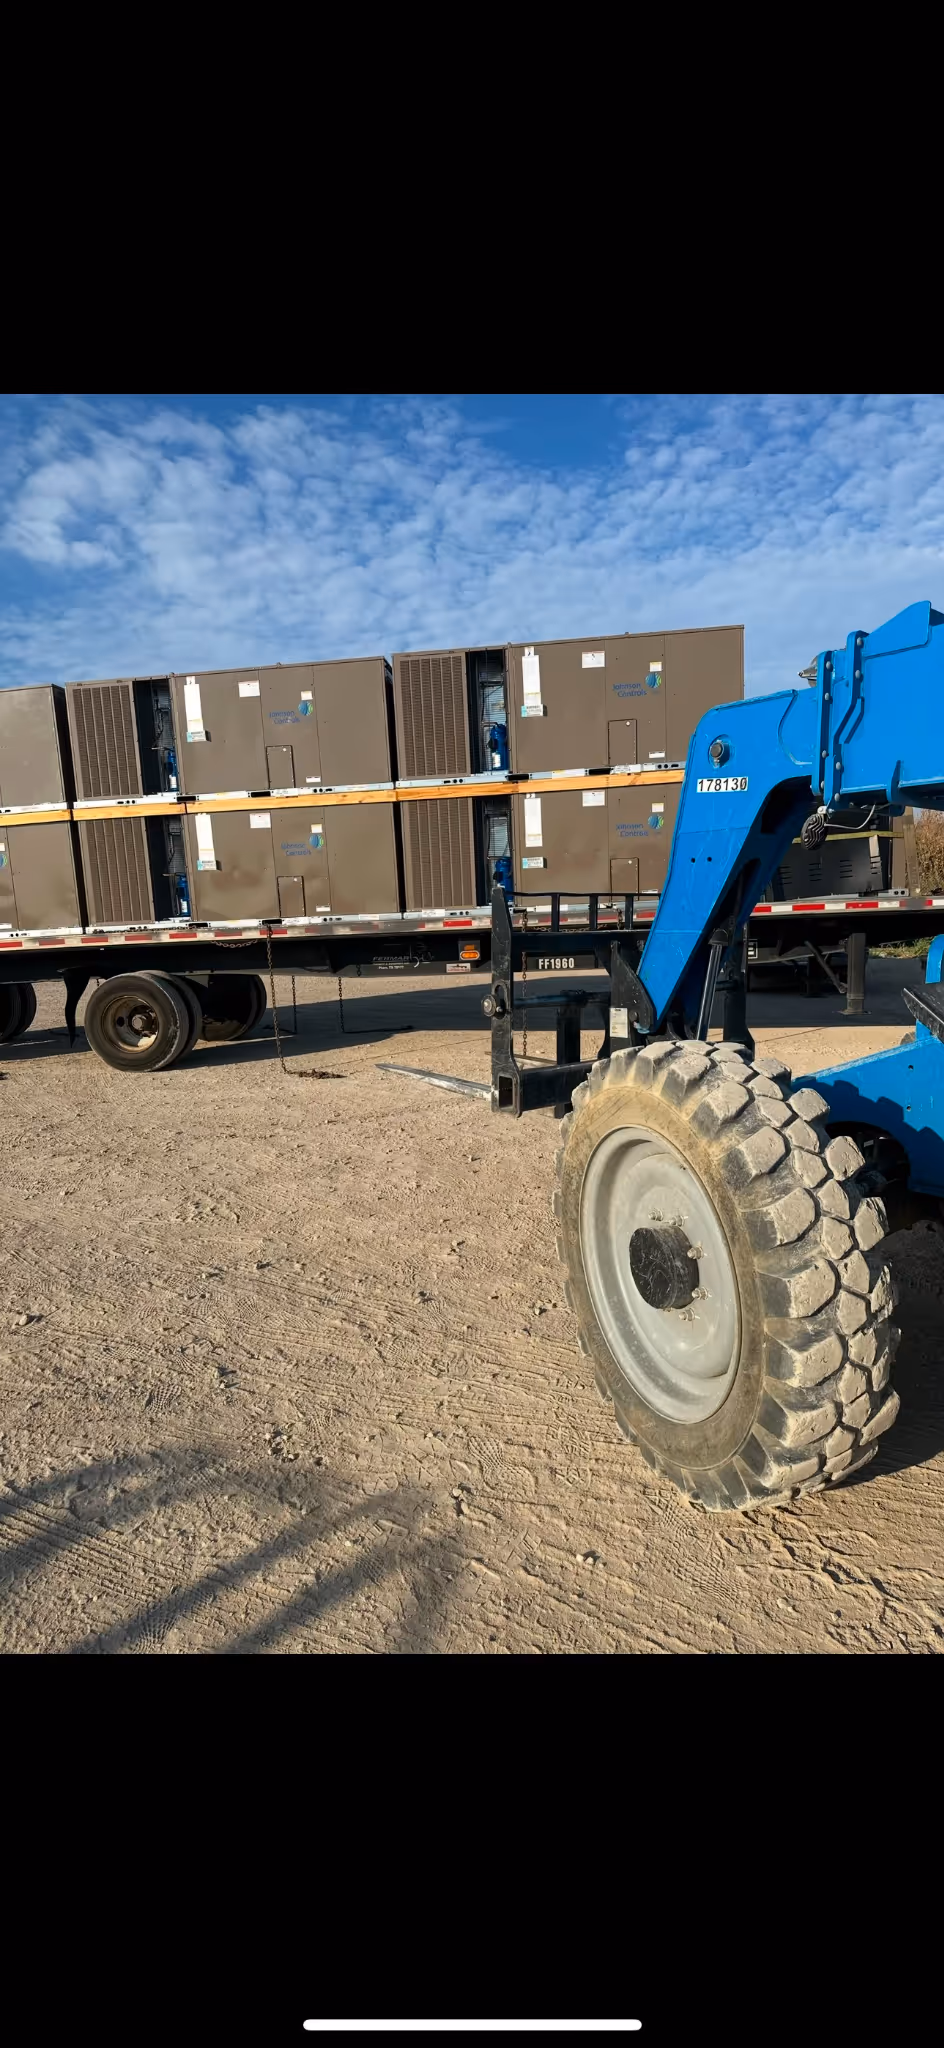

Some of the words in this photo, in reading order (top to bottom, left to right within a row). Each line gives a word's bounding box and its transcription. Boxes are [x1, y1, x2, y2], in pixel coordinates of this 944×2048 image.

[617, 688, 648, 698] Controls
[698, 777, 747, 792] 178130
[538, 957, 575, 970] FF1960
